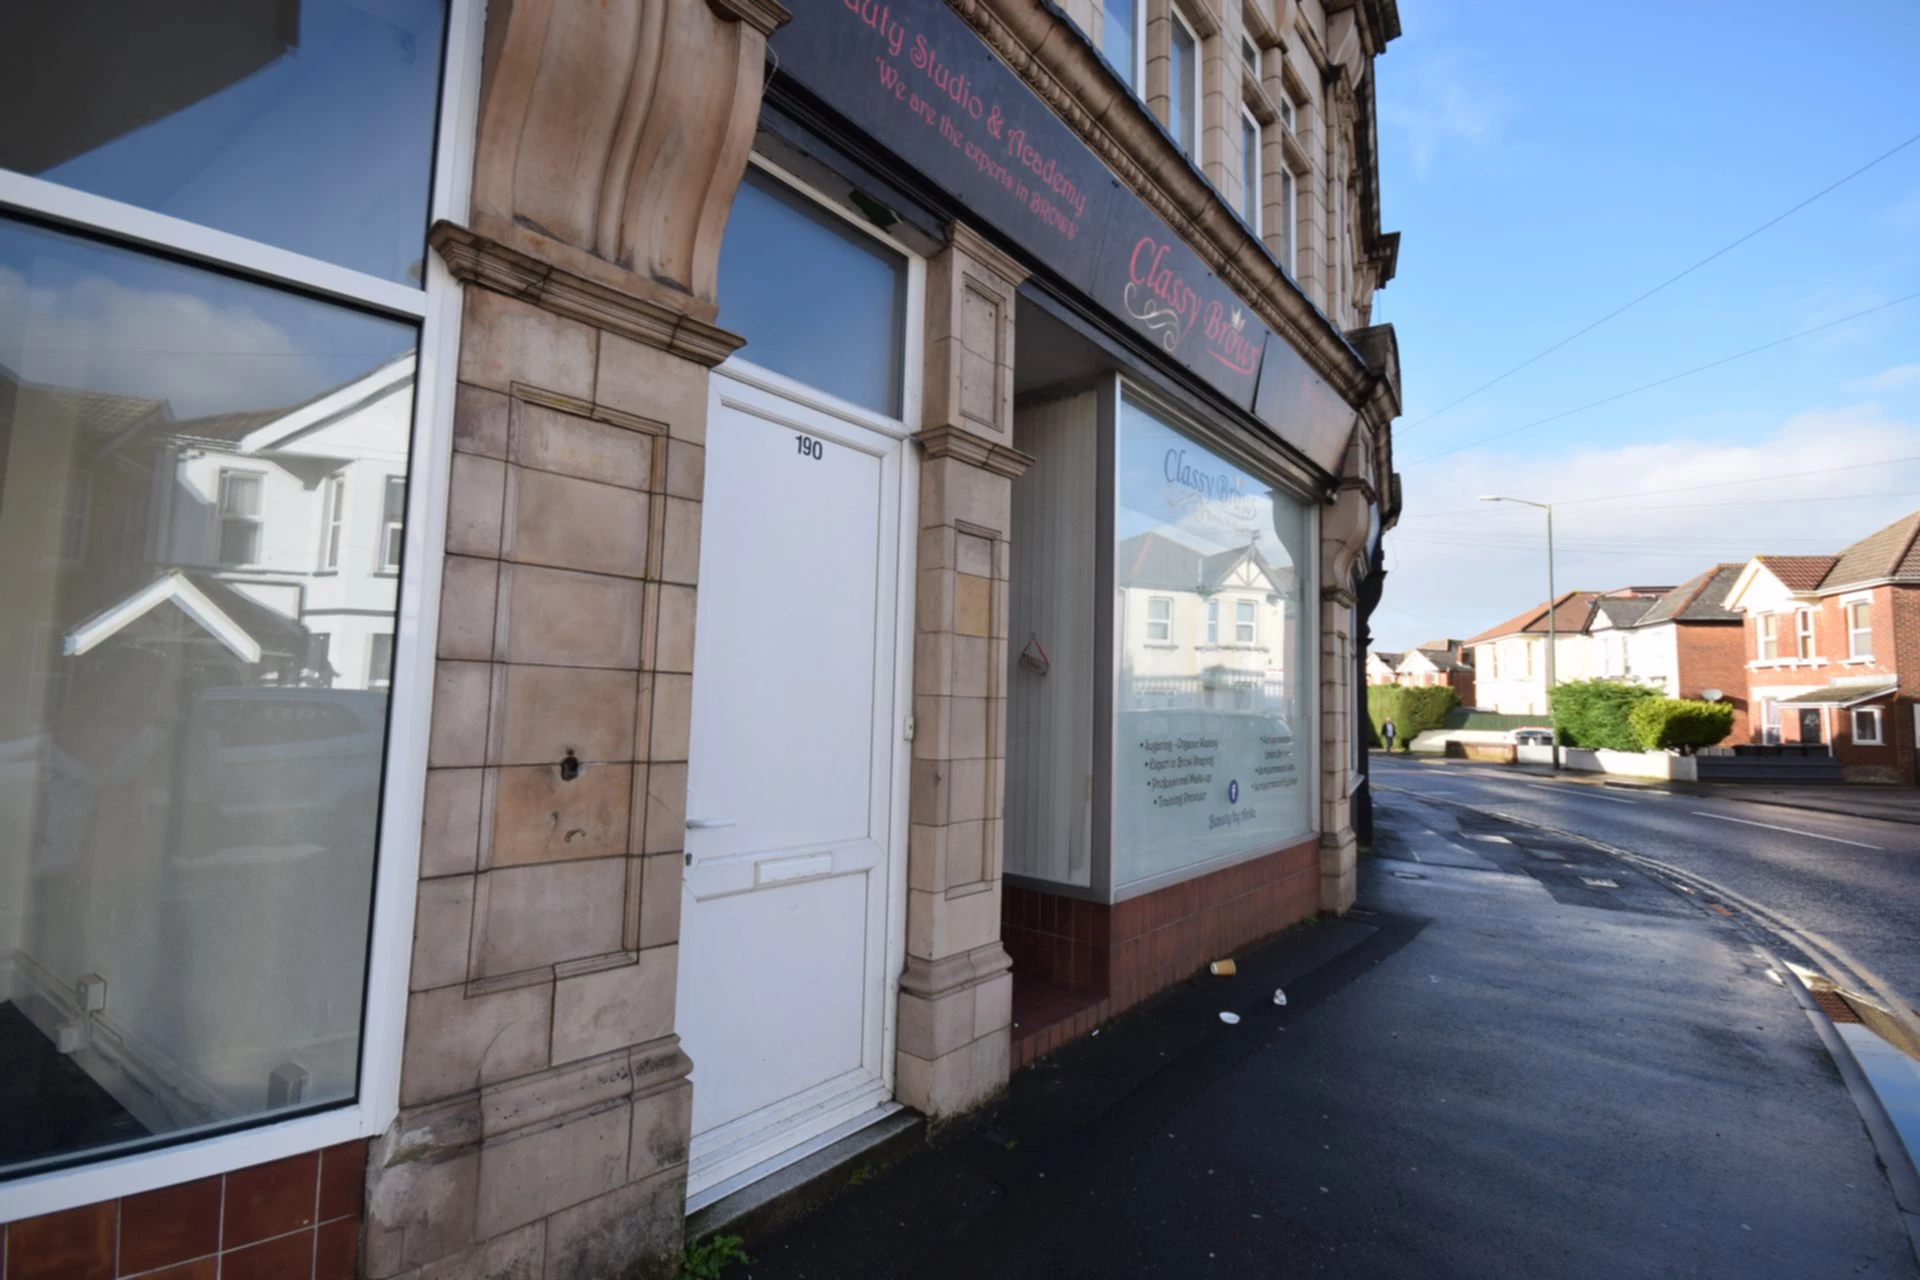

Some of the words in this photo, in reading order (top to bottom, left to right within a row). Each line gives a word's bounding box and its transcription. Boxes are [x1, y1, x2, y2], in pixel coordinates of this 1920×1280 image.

[908, 94, 936, 126] are
[939, 113, 962, 148] the
[964, 141, 1013, 190] experts
[1016, 178, 1028, 201] in
[911, 34, 984, 120] Studio
[987, 105, 1005, 140] &
[1007, 128, 1088, 217] Academy
[1128, 237, 1202, 344] Classy
[1203, 298, 1263, 374] Brows
[795, 434, 823, 461] 190
[1163, 447, 1215, 504] Classy
